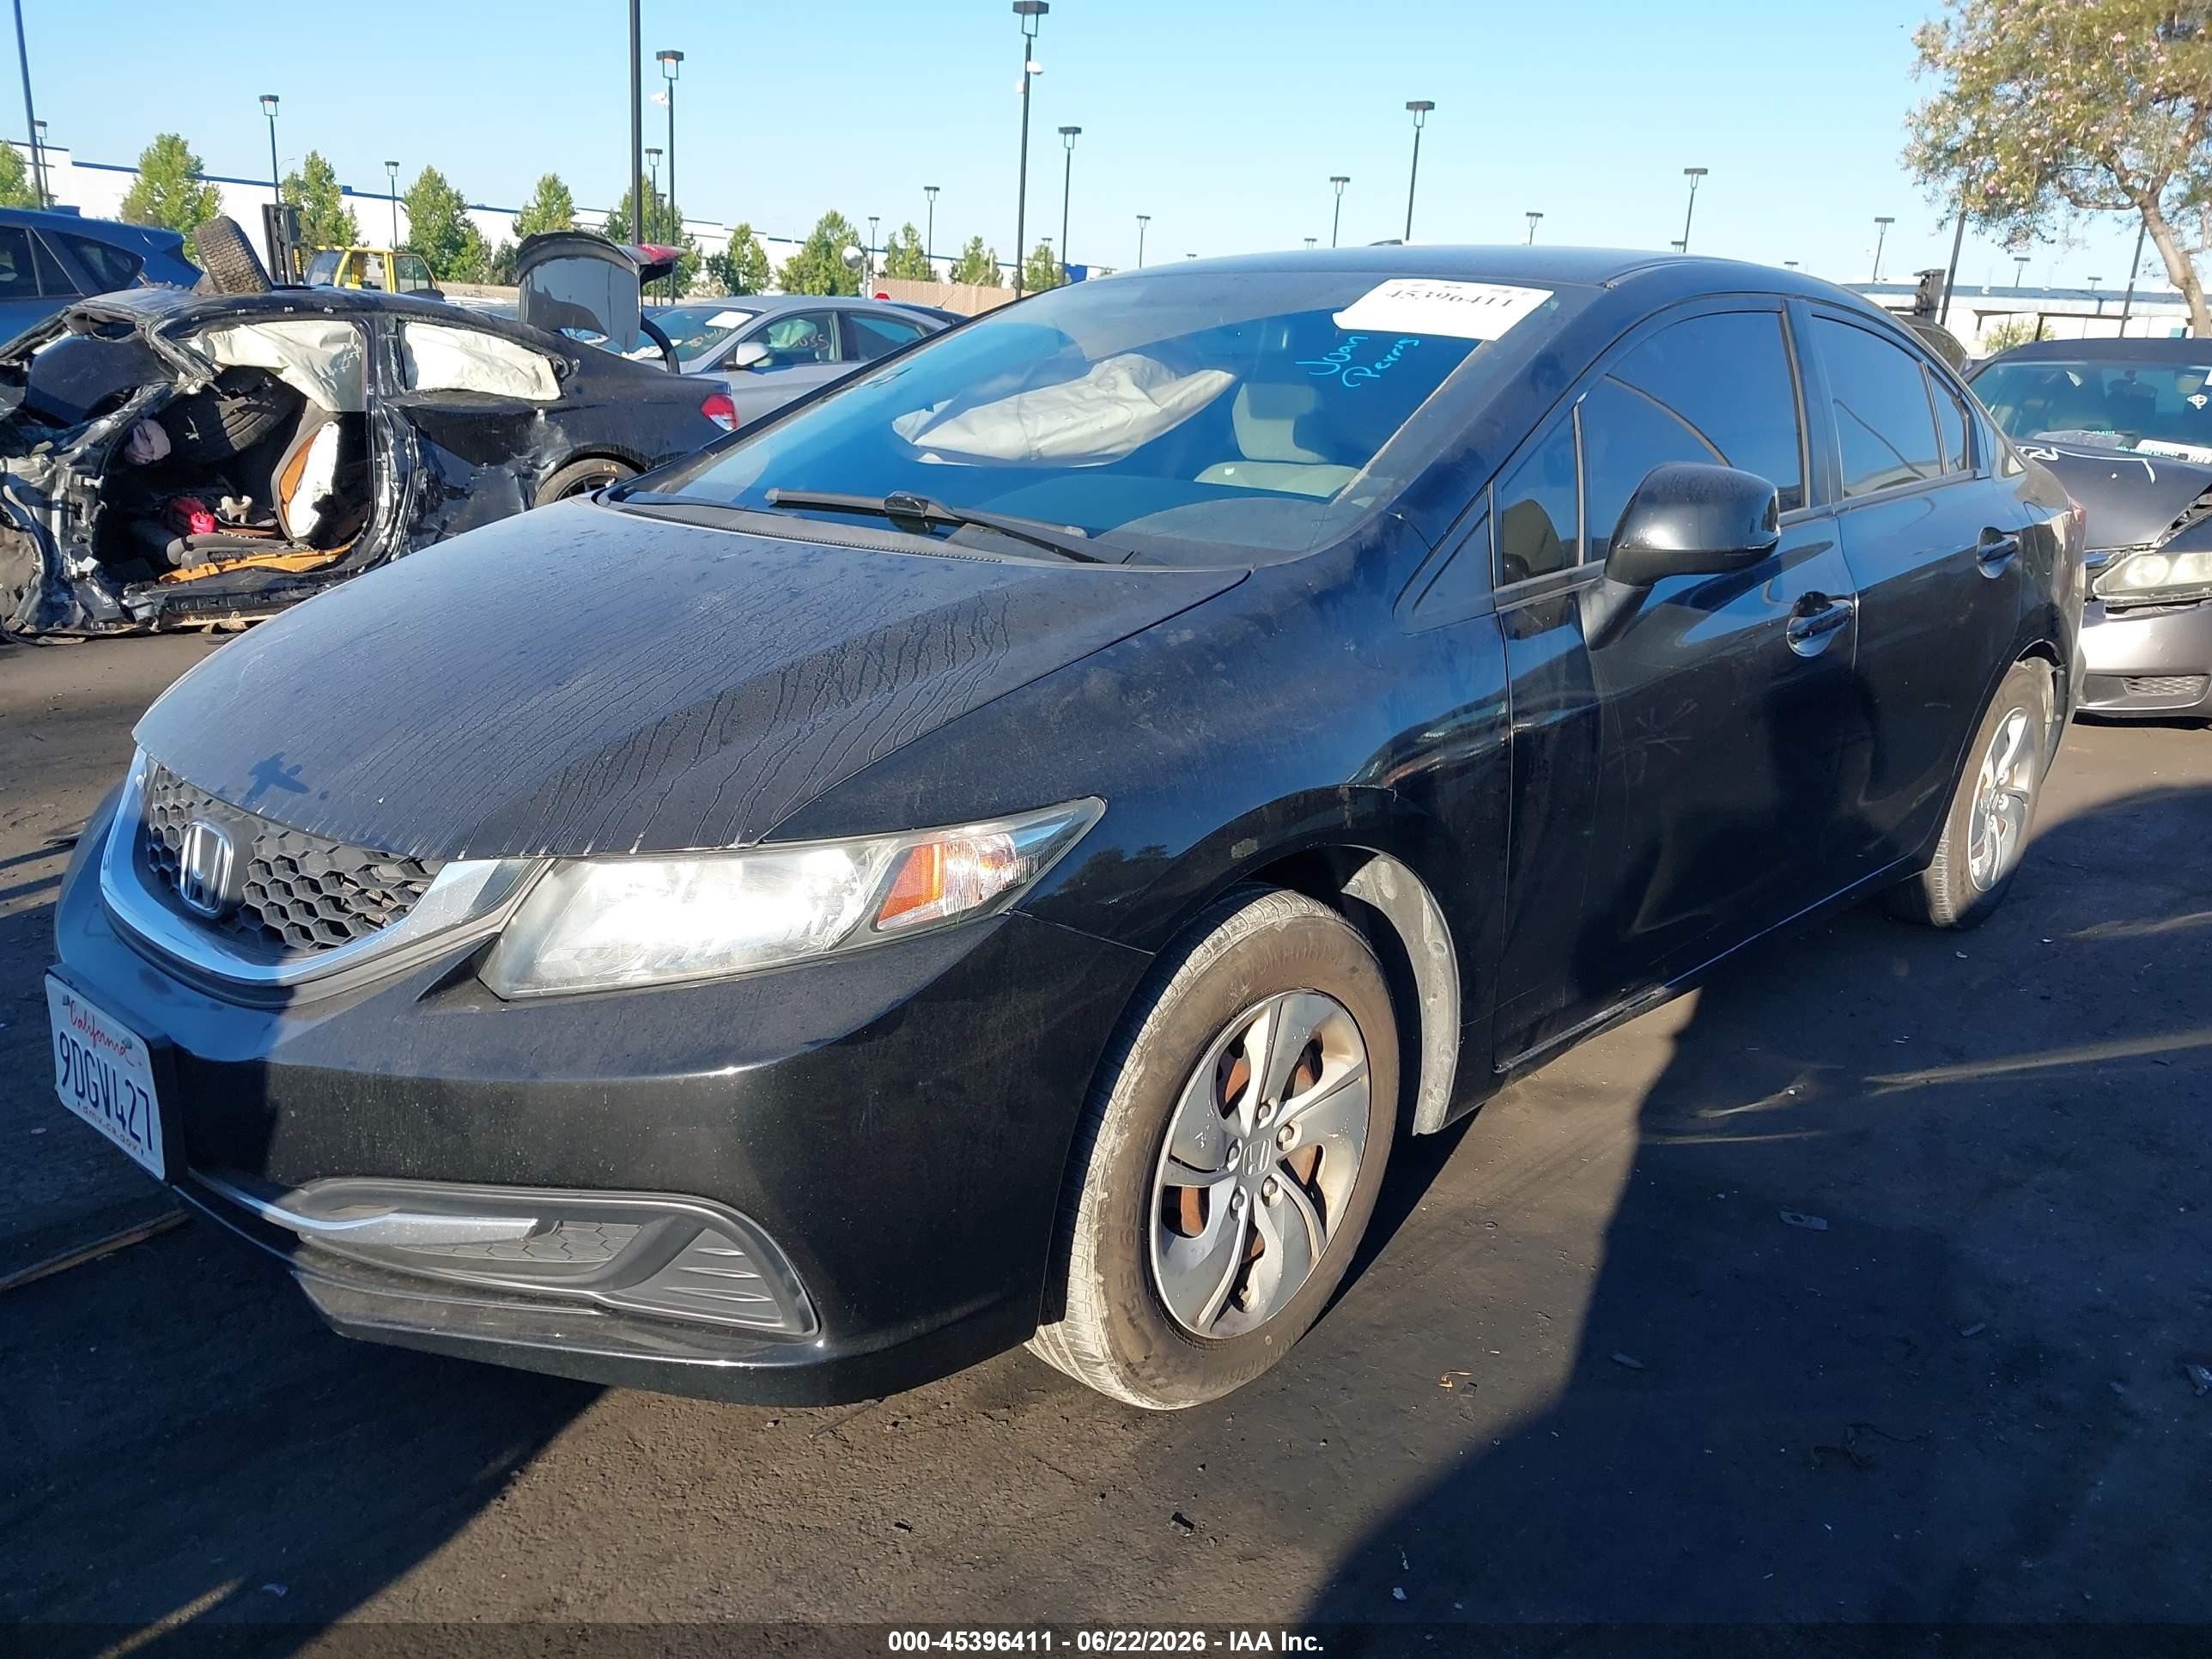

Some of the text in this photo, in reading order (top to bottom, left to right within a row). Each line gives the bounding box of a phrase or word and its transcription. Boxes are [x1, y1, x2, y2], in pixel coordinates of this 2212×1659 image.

[68, 999, 134, 1066] California
[59, 1031, 152, 1152] 9DGV427
[83, 1106, 138, 1152] dmv.ca.gov
